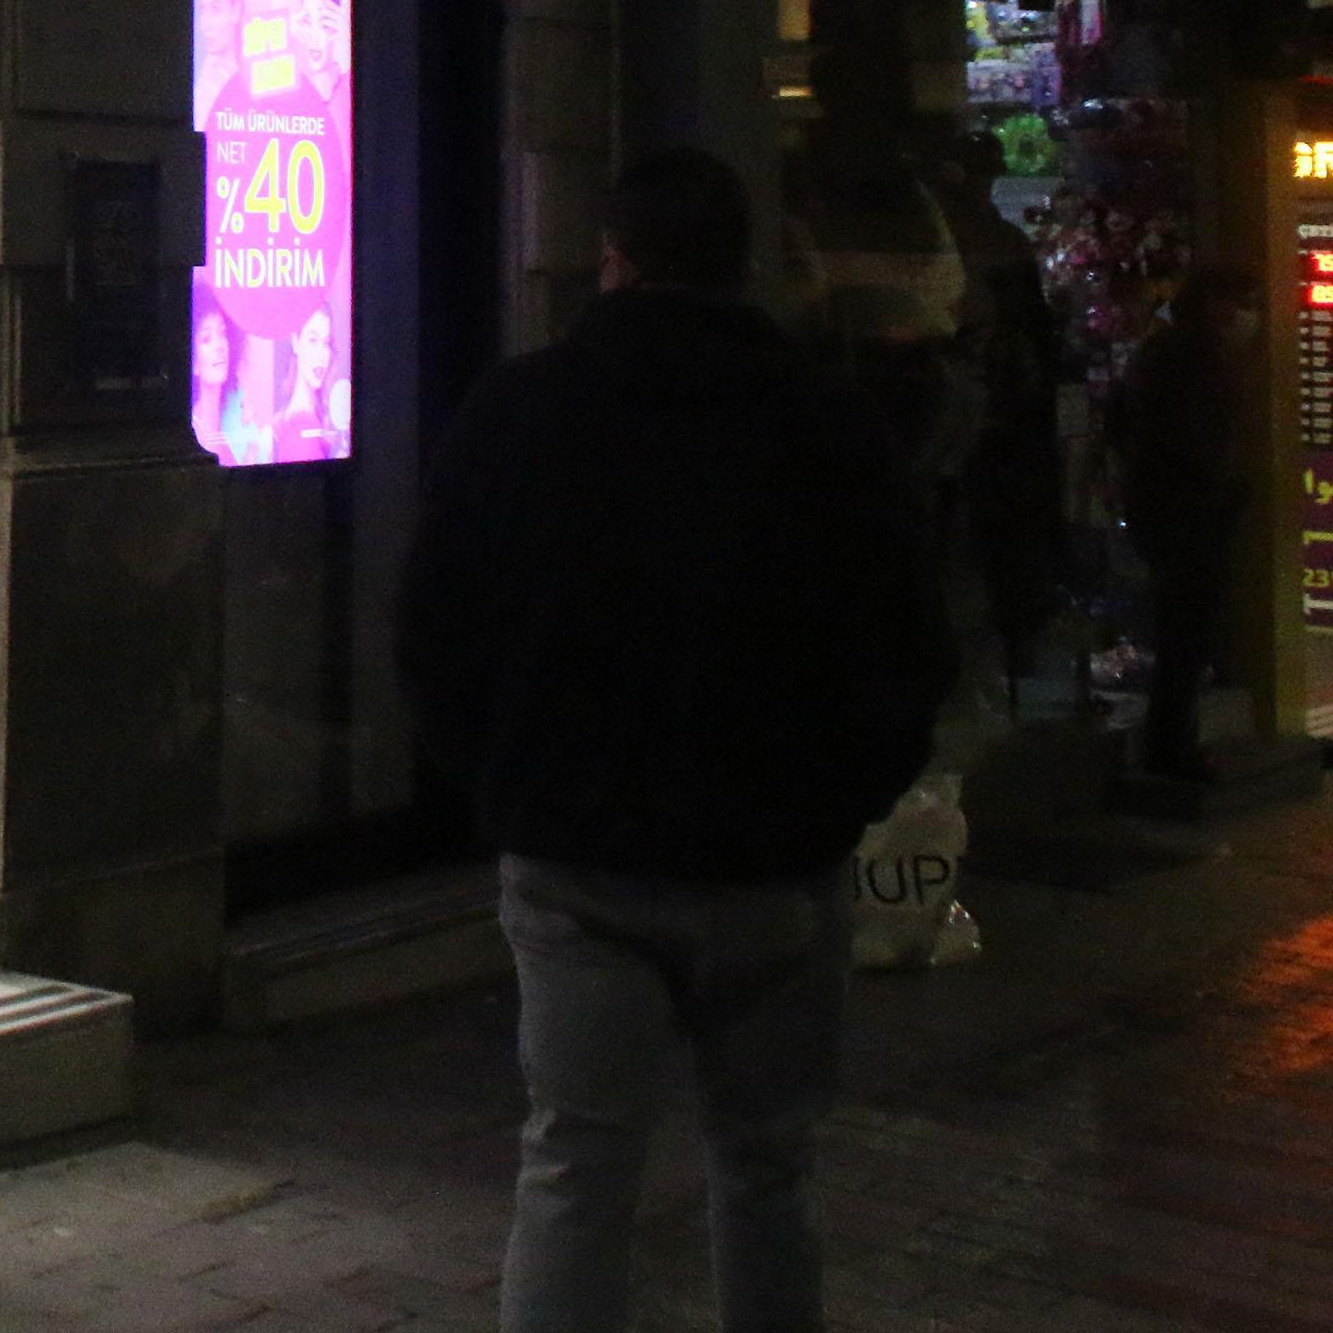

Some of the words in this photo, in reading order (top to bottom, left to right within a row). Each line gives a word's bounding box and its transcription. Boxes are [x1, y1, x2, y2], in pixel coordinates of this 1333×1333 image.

[215, 108, 245, 132] TÜM
[248, 109, 326, 136] ÜRÜNLERDE
[217, 141, 247, 165] NET
[214, 237, 326, 289] İNDİRİM
